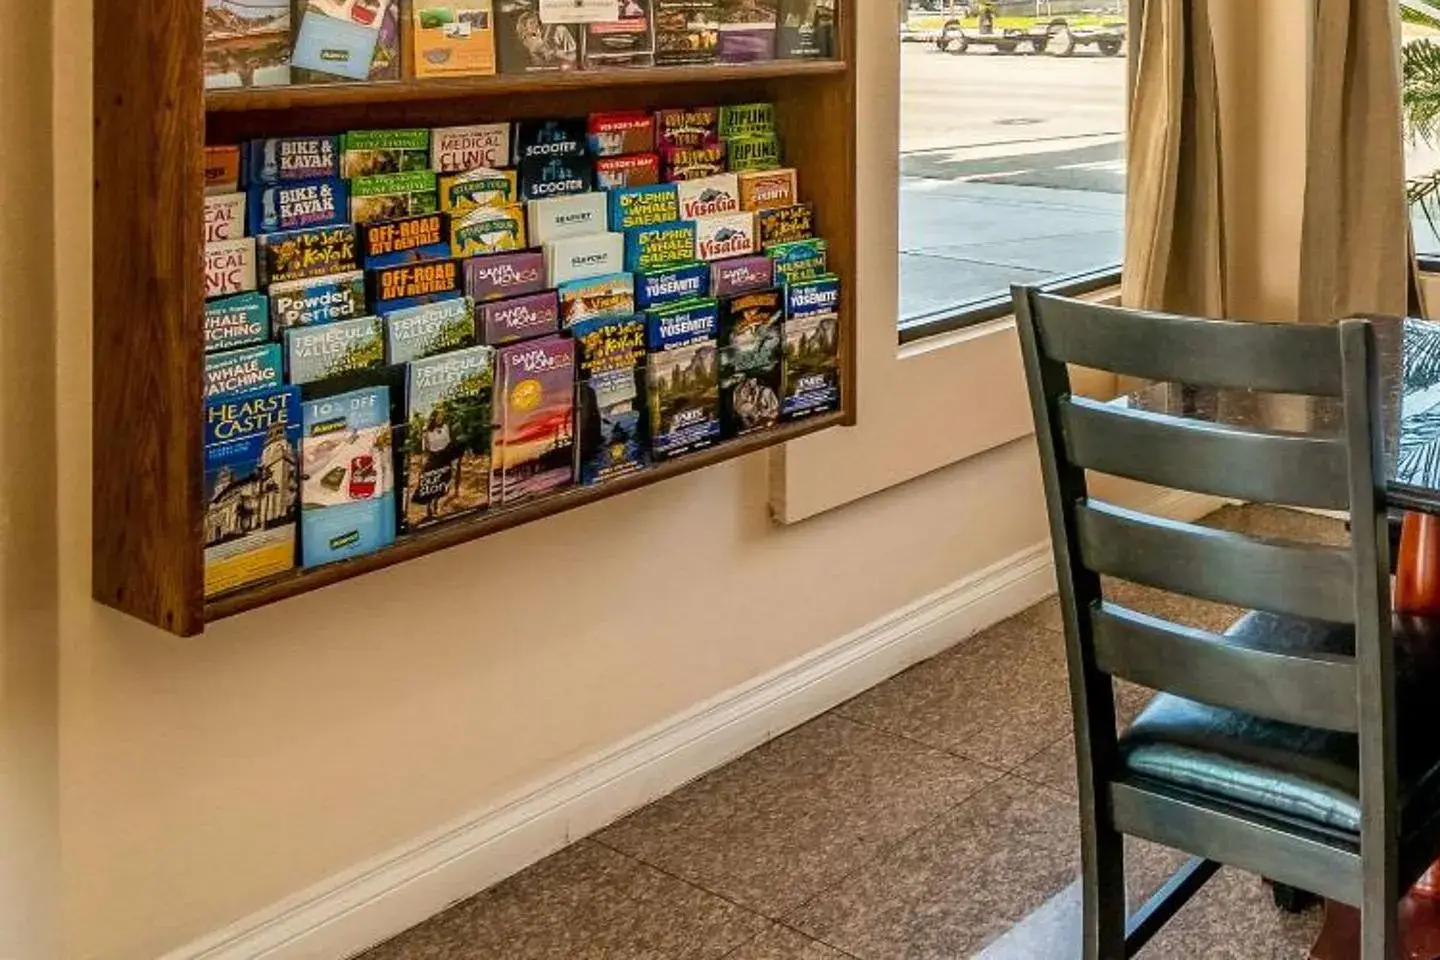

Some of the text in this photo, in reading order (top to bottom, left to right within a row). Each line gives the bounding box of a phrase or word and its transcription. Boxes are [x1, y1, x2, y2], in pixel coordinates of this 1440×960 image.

[281, 139, 332, 156] BIKE &
[441, 136, 502, 151] MEDICAL
[526, 141, 577, 157] SCOOTER
[735, 140, 777, 160] ZIPLINE
[281, 154, 333, 170] KAYAK
[440, 149, 496, 170] CLINIC
[280, 183, 332, 204] BIKE &
[532, 179, 583, 195] SCOOTER
[280, 197, 335, 218] KAYAK
[620, 191, 675, 206] DOLPHIN
[684, 193, 736, 218] Visalia
[369, 217, 440, 243] OFF-ROAD
[639, 228, 693, 244] DOLPHIN
[371, 232, 440, 255] ATV RENTALS
[647, 239, 693, 253] WHALE
[700, 232, 752, 259] Visalia
[204, 253, 246, 270] ICAL
[479, 263, 513, 280] SANTA
[382, 262, 456, 287] OFF-ROAD
[493, 268, 538, 287] MONICA
[383, 277, 455, 300] ATV RENTALS
[647, 277, 700, 298] YOSEMITE
[278, 289, 352, 314] Powder
[790, 290, 837, 307] YOSEMITE
[285, 299, 355, 326] Perfect
[393, 303, 466, 331] TEMECULA
[494, 305, 528, 322] SANTA
[506, 308, 553, 330] MONICA
[204, 322, 262, 340] TCHING
[295, 325, 374, 349] TEMECULA
[394, 321, 442, 340] VALLEY
[660, 316, 714, 338] YOSEMITE
[294, 341, 348, 358] VALLEY
[511, 349, 546, 367] SANTA
[208, 360, 260, 383] WHALE
[416, 354, 488, 378] TEMECULA
[524, 352, 570, 373] MONICA
[416, 370, 465, 389] VALLEY
[209, 392, 293, 424] HEARST
[214, 410, 289, 439] CASTLE
